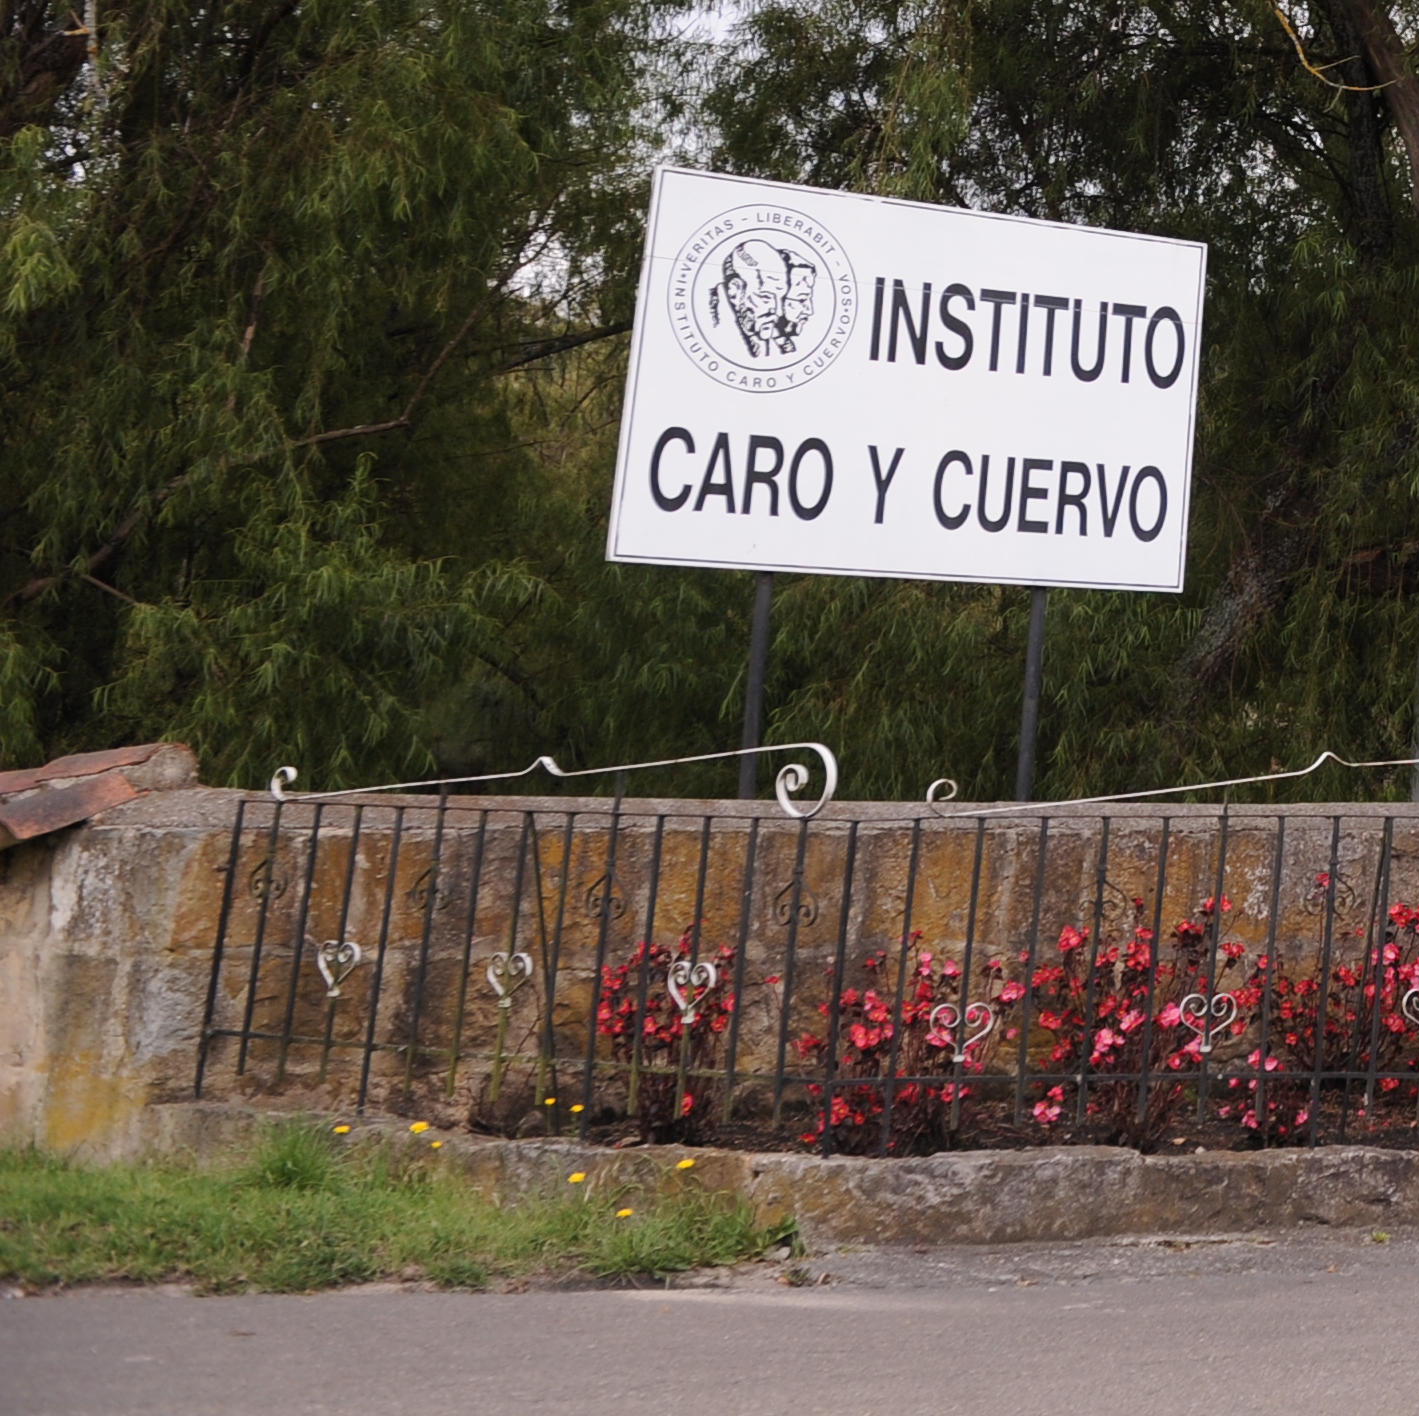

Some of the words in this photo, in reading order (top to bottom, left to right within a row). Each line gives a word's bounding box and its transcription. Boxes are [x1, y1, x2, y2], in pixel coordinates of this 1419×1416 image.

[681, 219, 734, 272] VERITAS
[756, 212, 836, 255] LIBERABIT
[838, 274, 853, 307] VOS
[674, 278, 720, 372] INSTITUTO
[725, 370, 777, 389] CARO
[785, 372, 795, 384] Y
[802, 314, 851, 376] CUERVO
[869, 276, 1186, 390] INSTITUTO
[649, 426, 834, 521] CARO
[867, 445, 905, 525] Y
[933, 449, 1168, 543] CUERVO
